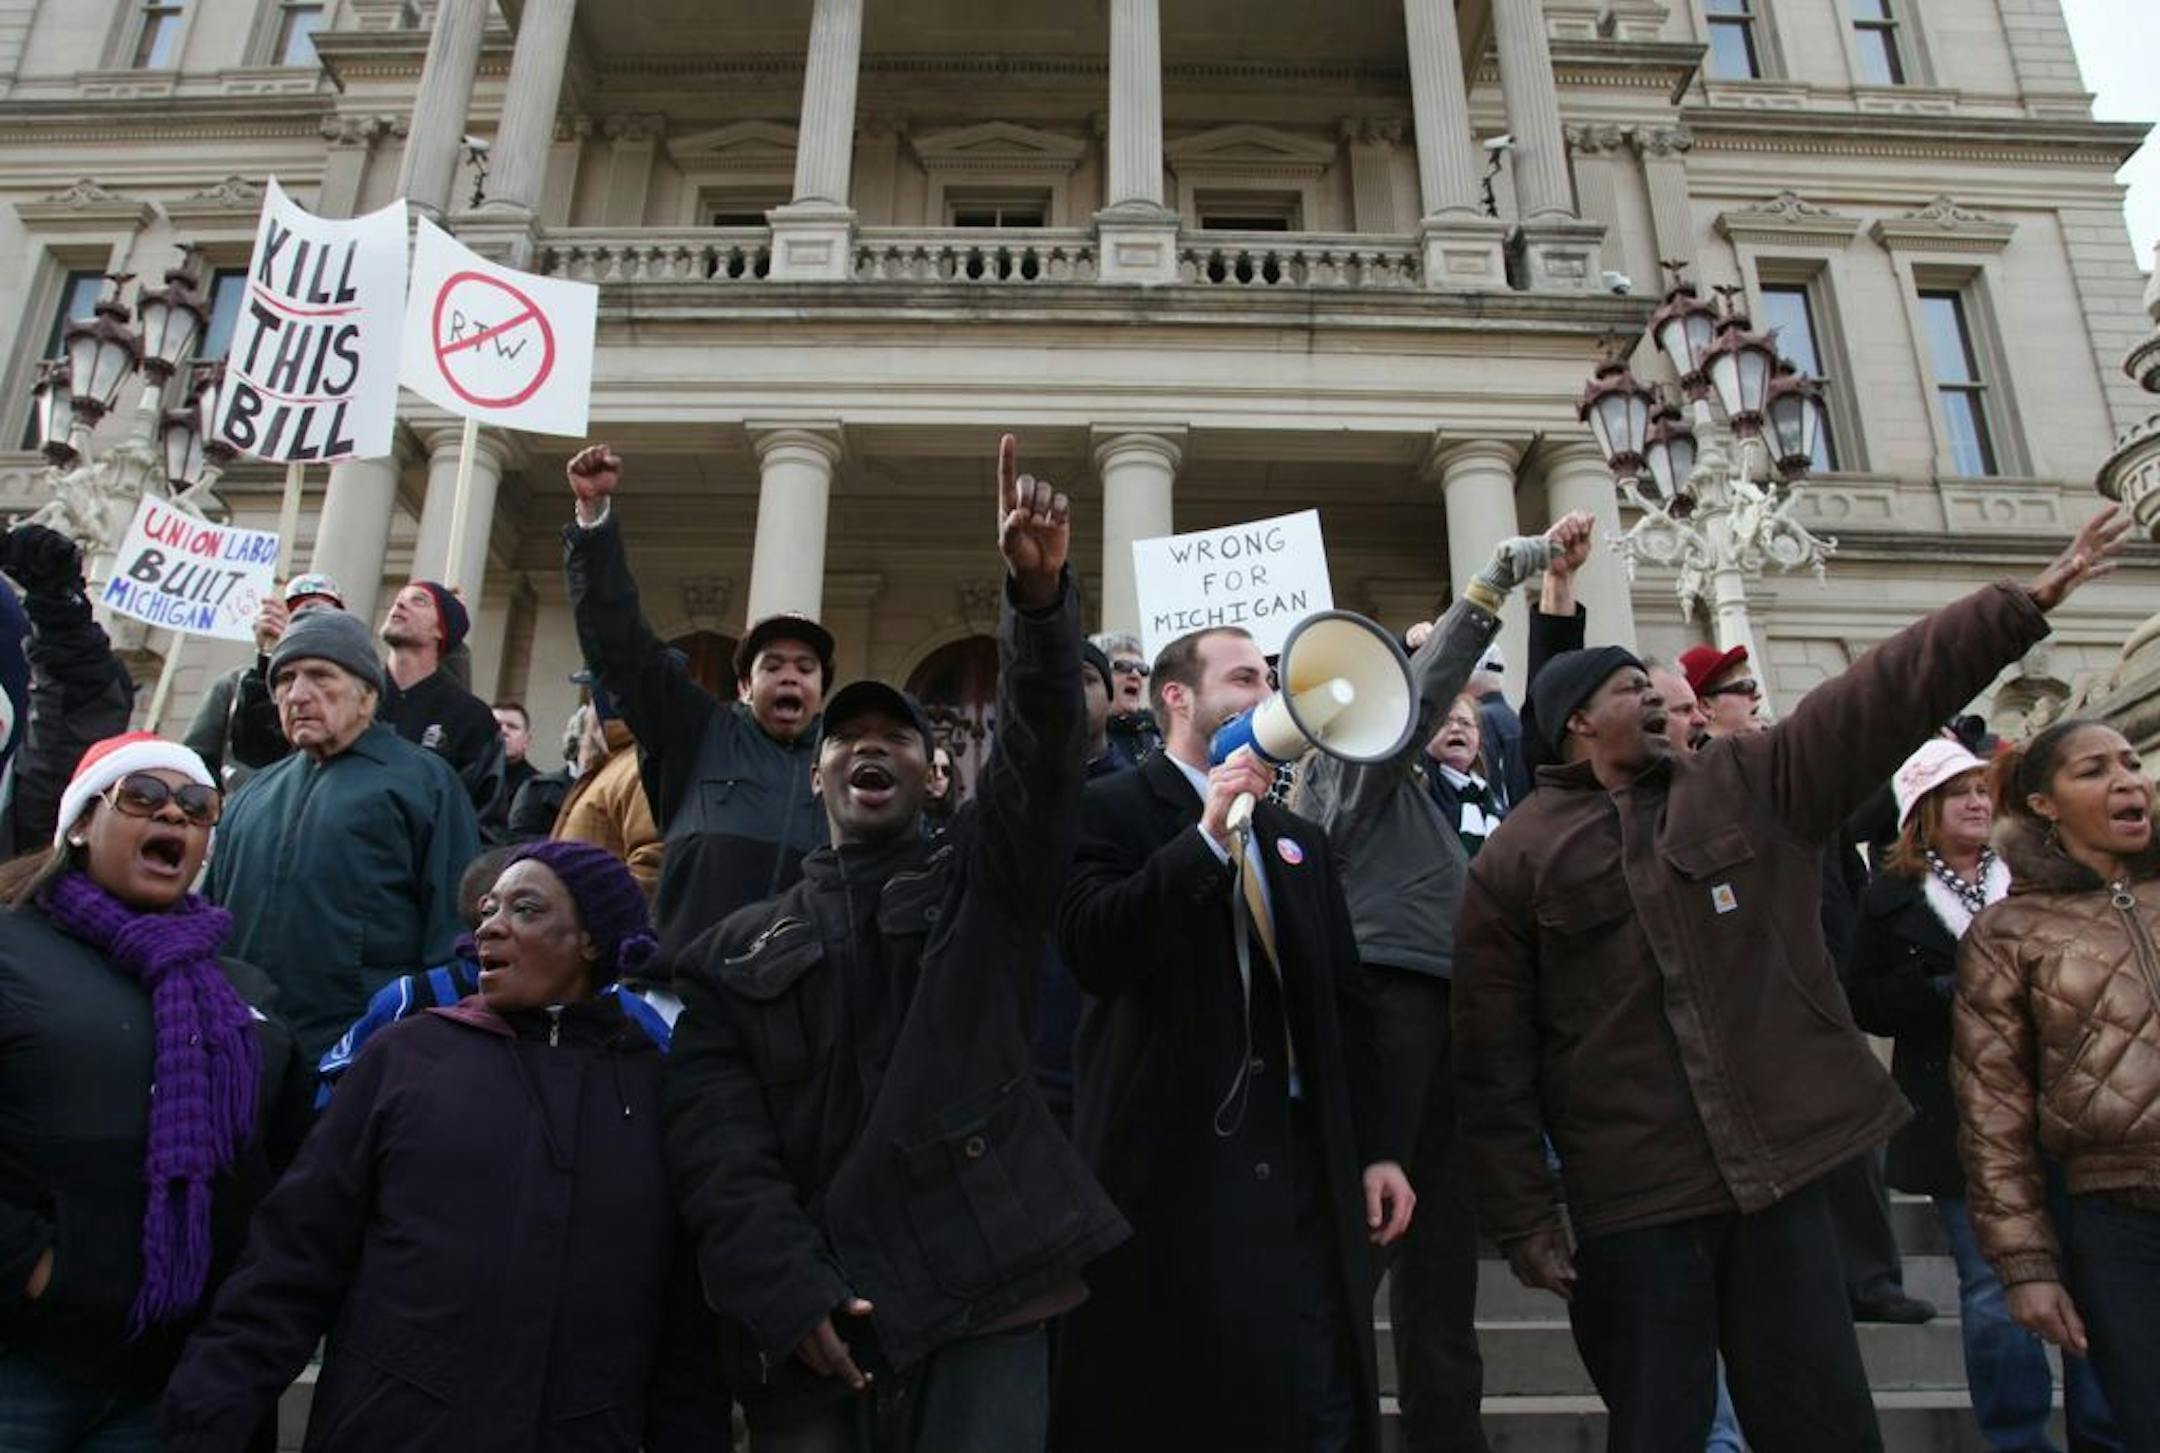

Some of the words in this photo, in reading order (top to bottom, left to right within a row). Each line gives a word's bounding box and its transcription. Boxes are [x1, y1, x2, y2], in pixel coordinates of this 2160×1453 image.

[258, 218, 358, 304] KILL
[244, 297, 360, 396] THIS
[449, 309, 527, 360] RTW
[223, 381, 354, 460] BILL
[143, 507, 224, 557] UNION
[1168, 527, 1286, 565] WRONG
[128, 548, 246, 605] BUILT
[1203, 565, 1269, 596] FOR
[104, 576, 217, 630] MICHIGAN
[1154, 590, 1308, 633] MICHIGAN
